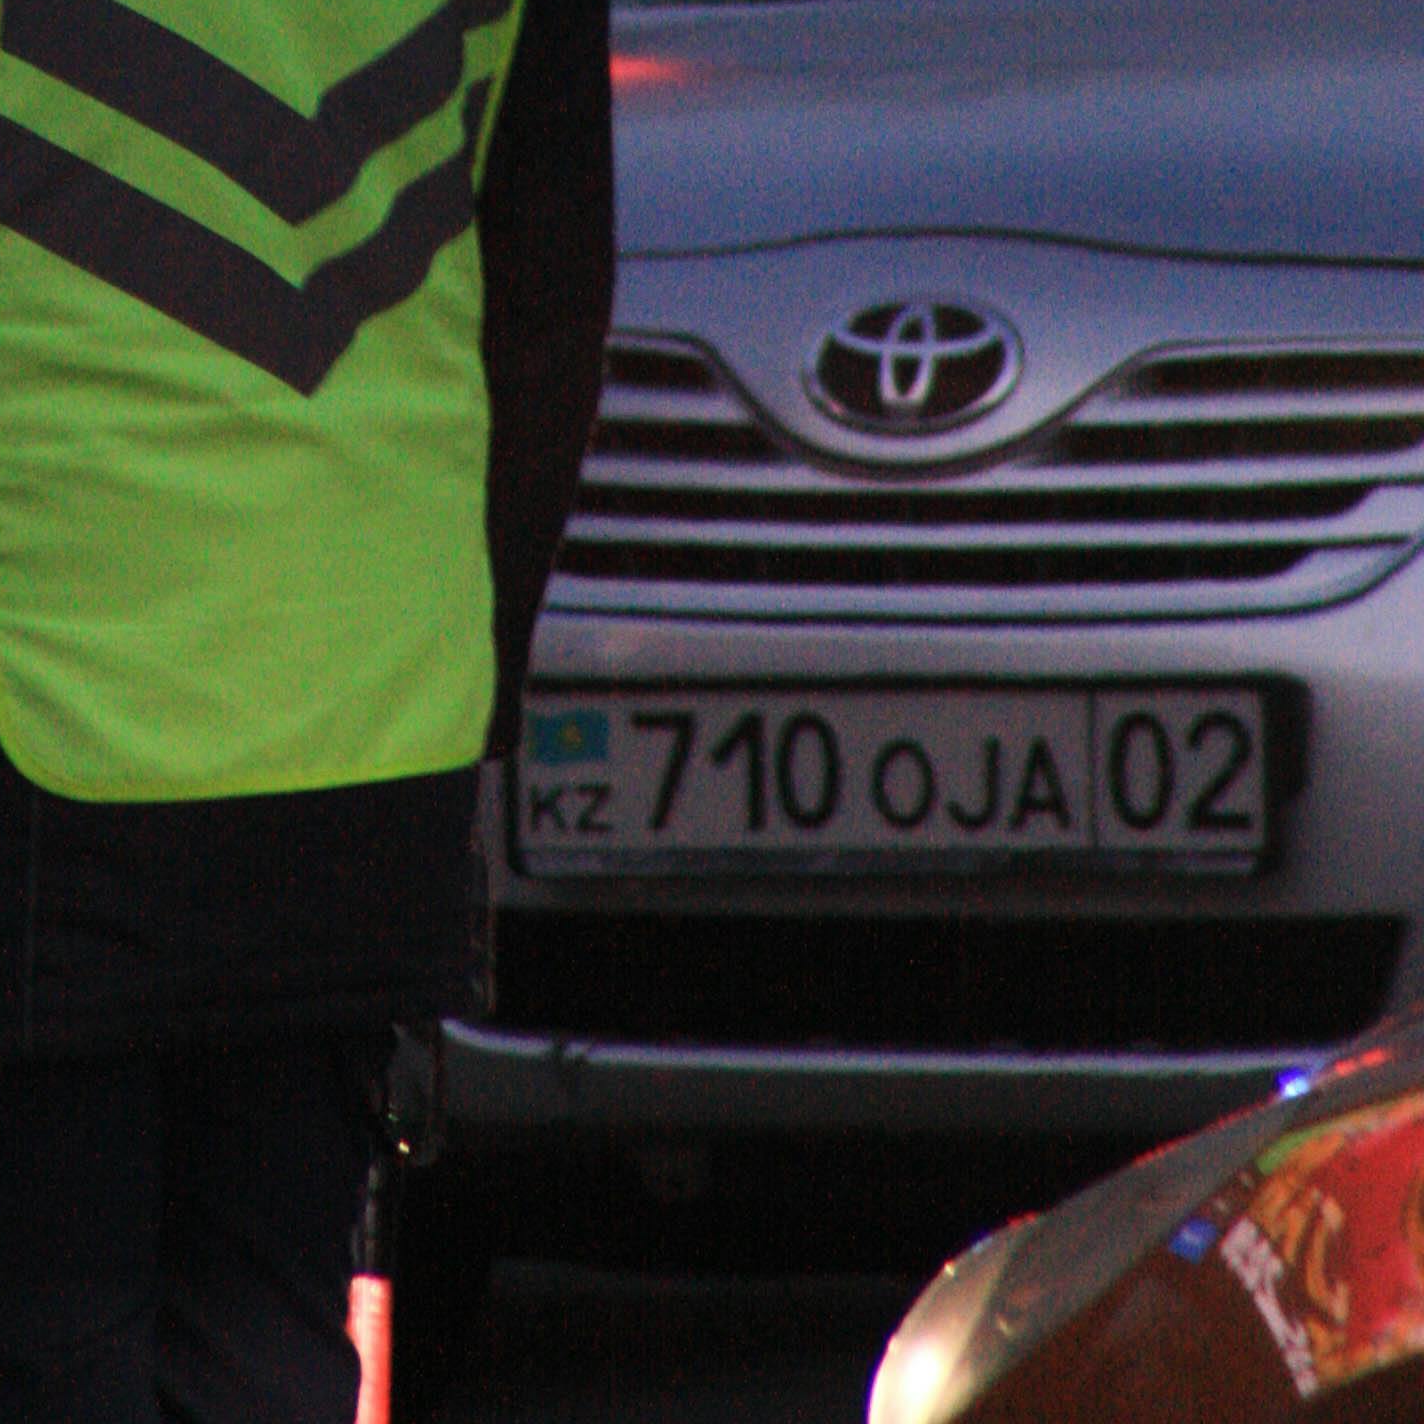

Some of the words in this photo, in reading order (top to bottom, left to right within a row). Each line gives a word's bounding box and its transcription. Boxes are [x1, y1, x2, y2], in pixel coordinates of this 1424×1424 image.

[528, 783, 614, 833] KZ
[630, 711, 839, 832] 710
[870, 737, 1071, 831] OJA
[1107, 709, 1253, 831] 02
